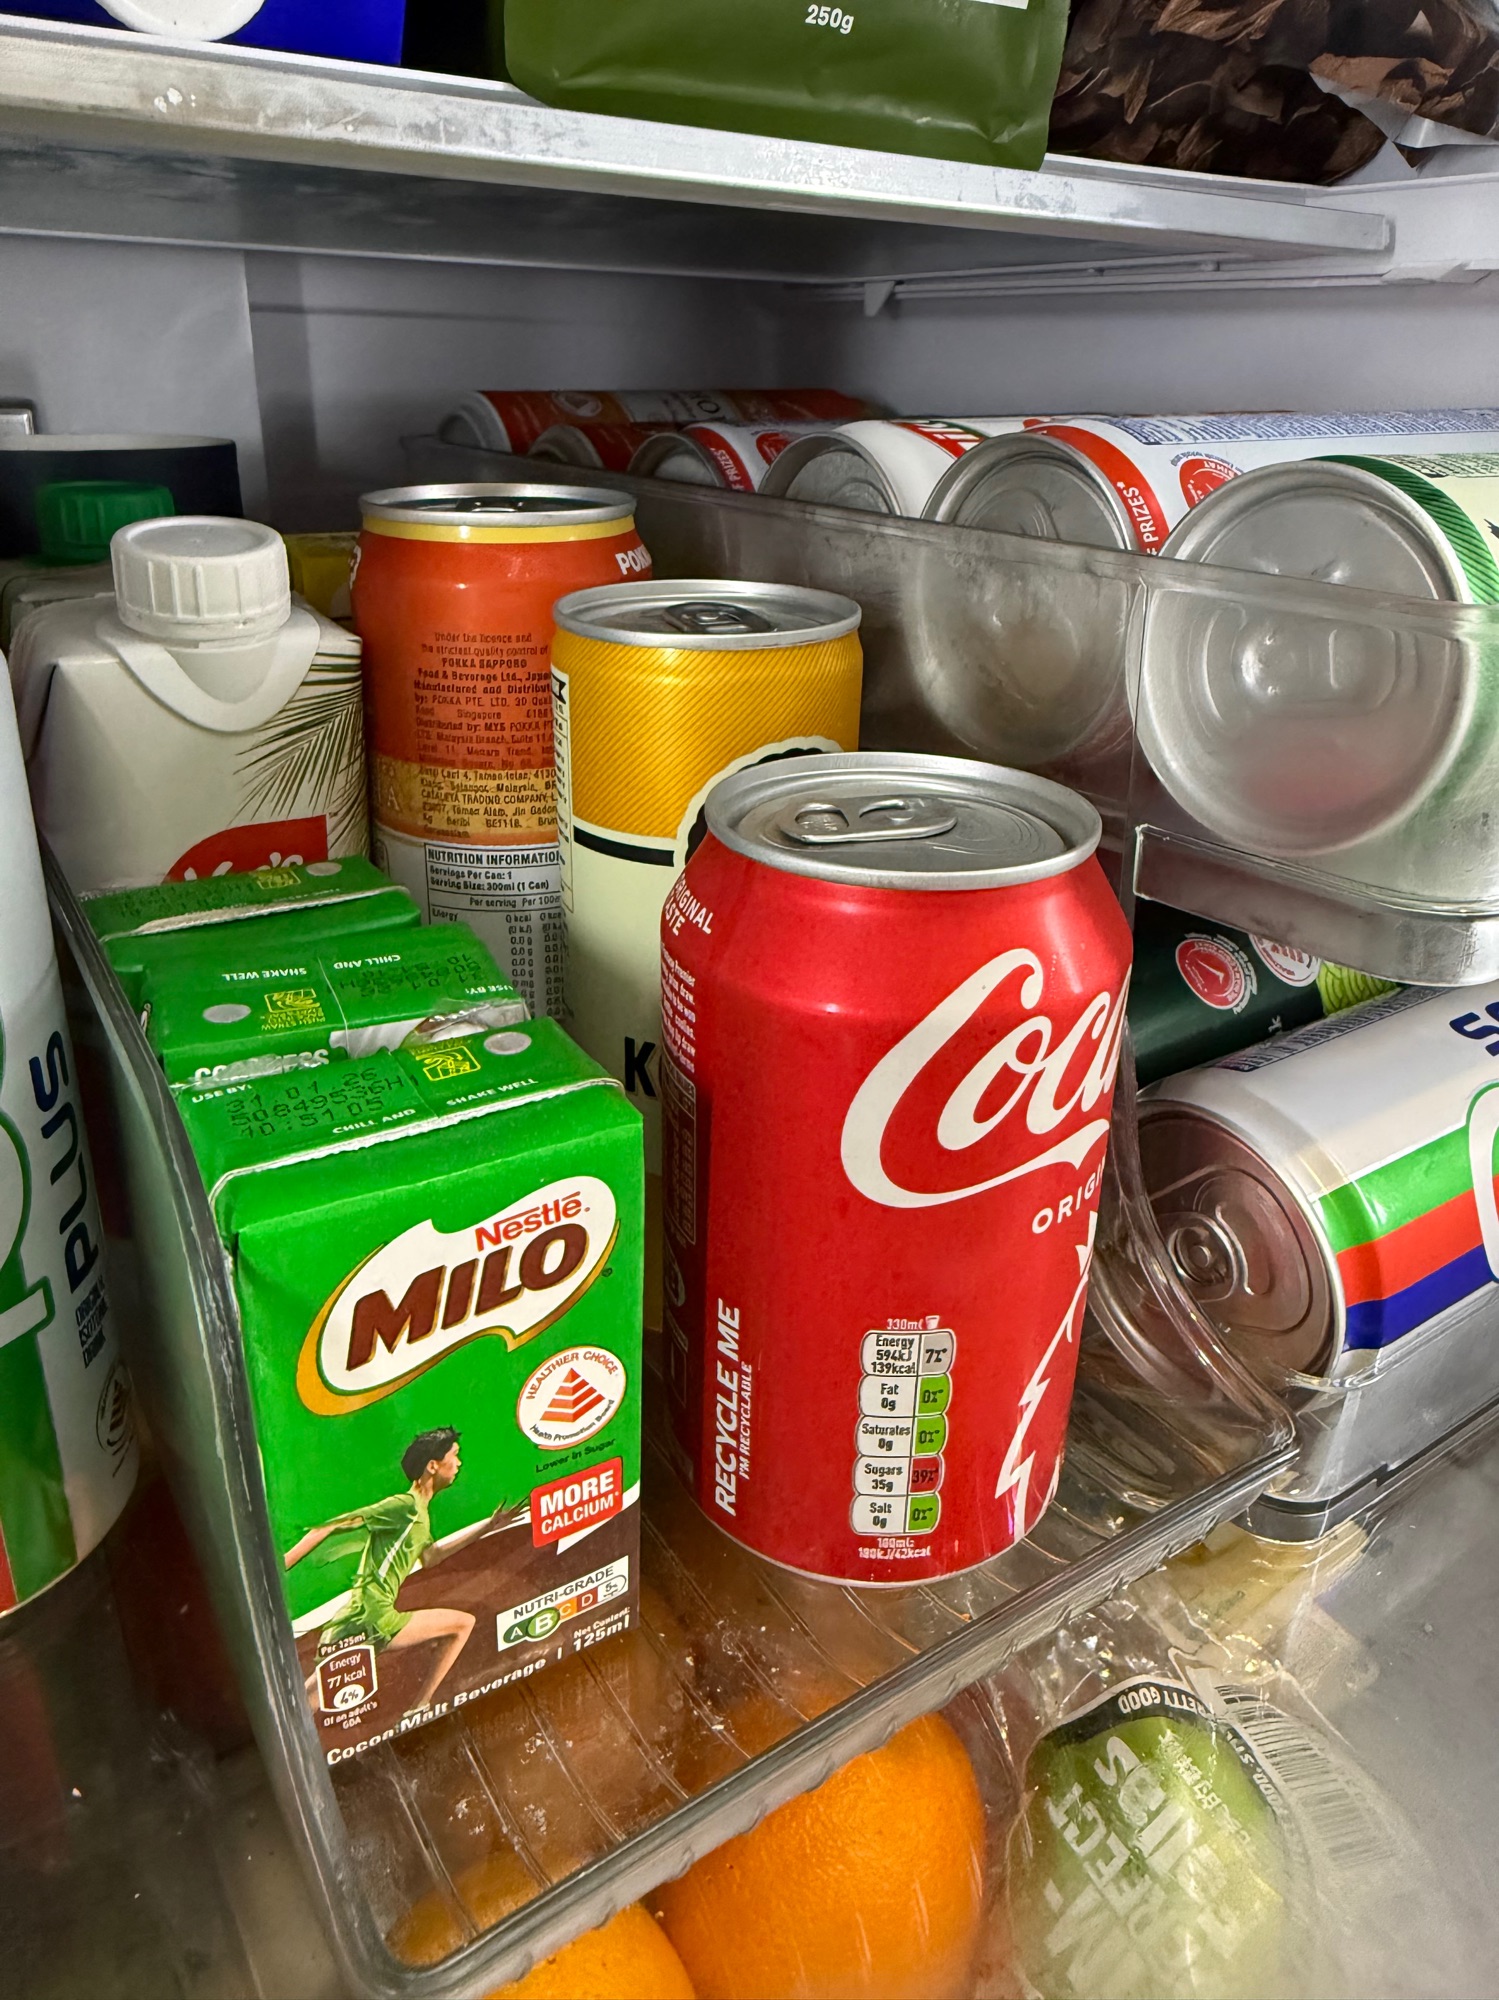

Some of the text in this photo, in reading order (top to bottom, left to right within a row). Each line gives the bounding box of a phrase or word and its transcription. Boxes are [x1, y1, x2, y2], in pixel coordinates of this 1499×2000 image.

[805, 4, 854, 35] 250g
[516, 633, 532, 642] and
[506, 646, 537, 656] control
[541, 645, 548, 655] of
[442, 658, 527, 669] POKKA SAPPORO
[418, 668, 439, 678] Food
[442, 670, 448, 679] &
[452, 671, 497, 683] Beverage
[414, 680, 550, 694] Manufactured and Distribut
[457, 709, 501, 720] Singapore
[510, 722, 540, 731] POKKA
[462, 794, 500, 805] TRADING
[428, 849, 482, 864] NUTRITION
[430, 865, 512, 879] Servings Per Can: 1
[431, 877, 549, 892] Serving Size: 300ml (1 Can)
[470, 897, 536, 908] Per serving Per
[514, 913, 531, 922] kcal
[665, 890, 686, 936] ASTE
[511, 936, 532, 946] 0.0 g
[511, 947, 532, 957] 0.0 g
[334, 954, 401, 970] CHILL AND
[512, 958, 525, 966] 0.0
[222, 967, 307, 982] SHAKE WELL
[512, 969, 533, 978] 0.0 g
[192, 1084, 253, 1104] USE BY:
[226, 1094, 263, 1115] 31
[286, 1080, 319, 1100] 01
[446, 1078, 539, 1106] SHAKE WELL
[332, 1108, 416, 1134] CHILL AND
[29, 1030, 100, 1295] PLUS
[1032, 1154, 1106, 1235] ORIGI
[346, 1223, 590, 1372] MILO
[887, 1319, 924, 1330] 330ml
[876, 1334, 915, 1350] Energy
[877, 1350, 912, 1361] 594kJ
[526, 1351, 619, 1400] HEALTHIER CHOICE
[871, 1362, 915, 1374] 139kcal
[881, 1383, 899, 1395] Fat
[714, 1297, 740, 1517] RECYCLE ME
[881, 1398, 896, 1411] 0g
[738, 1360, 753, 1481] I'M RECYCLABLE
[862, 1423, 910, 1436] Saturates
[878, 1438, 893, 1451] 0g
[535, 1439, 616, 1473] Lower in Sugar
[864, 1463, 903, 1477] Sugars
[872, 1479, 893, 1492] 35g
[540, 1469, 615, 1518] MORE
[870, 1502, 892, 1514] Salt
[872, 1516, 887, 1528] 0g
[513, 1566, 615, 1620] NUTRI-GRADE
[510, 1627, 524, 1641] A
[535, 1613, 554, 1635] B
[560, 1603, 572, 1616] C
[581, 1593, 594, 1607] D
[573, 1606, 630, 1639] Net Content:
[573, 1614, 630, 1652] 125ml
[321, 1632, 366, 1656] Per 125ml
[329, 1652, 361, 1672] Energy
[327, 1665, 367, 1690] 77 kcal
[340, 1689, 359, 1704] 4%
[399, 1702, 450, 1733] Malt
[453, 1657, 547, 1708] Beverage
[1118, 1685, 1161, 1714] GOOD
[336, 1714, 347, 1723] an
[342, 1716, 362, 1730] GDA
